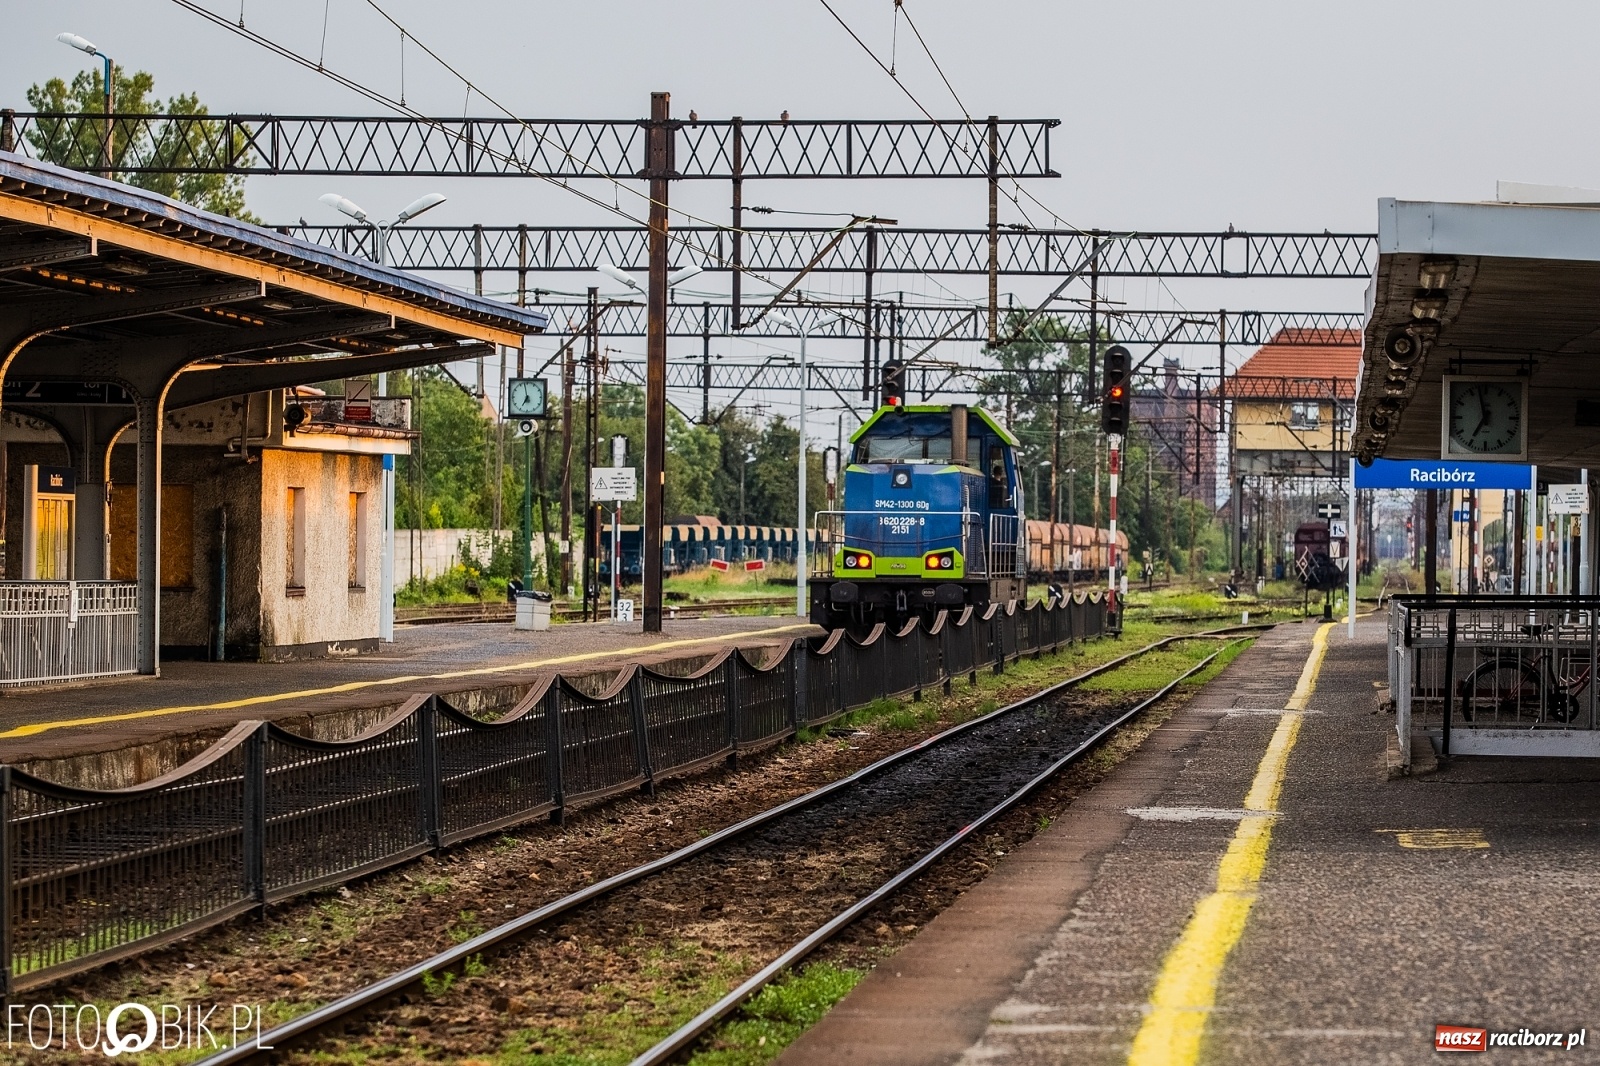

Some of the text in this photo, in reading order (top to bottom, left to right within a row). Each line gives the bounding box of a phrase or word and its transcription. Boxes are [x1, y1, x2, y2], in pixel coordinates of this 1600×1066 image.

[1410, 468, 1476, 482] Racibórz
[875, 499, 914, 509] SM42-1300
[891, 525, 910, 534] 2151
[619, 601, 631, 611] 32
[622, 612, 628, 621] 3
